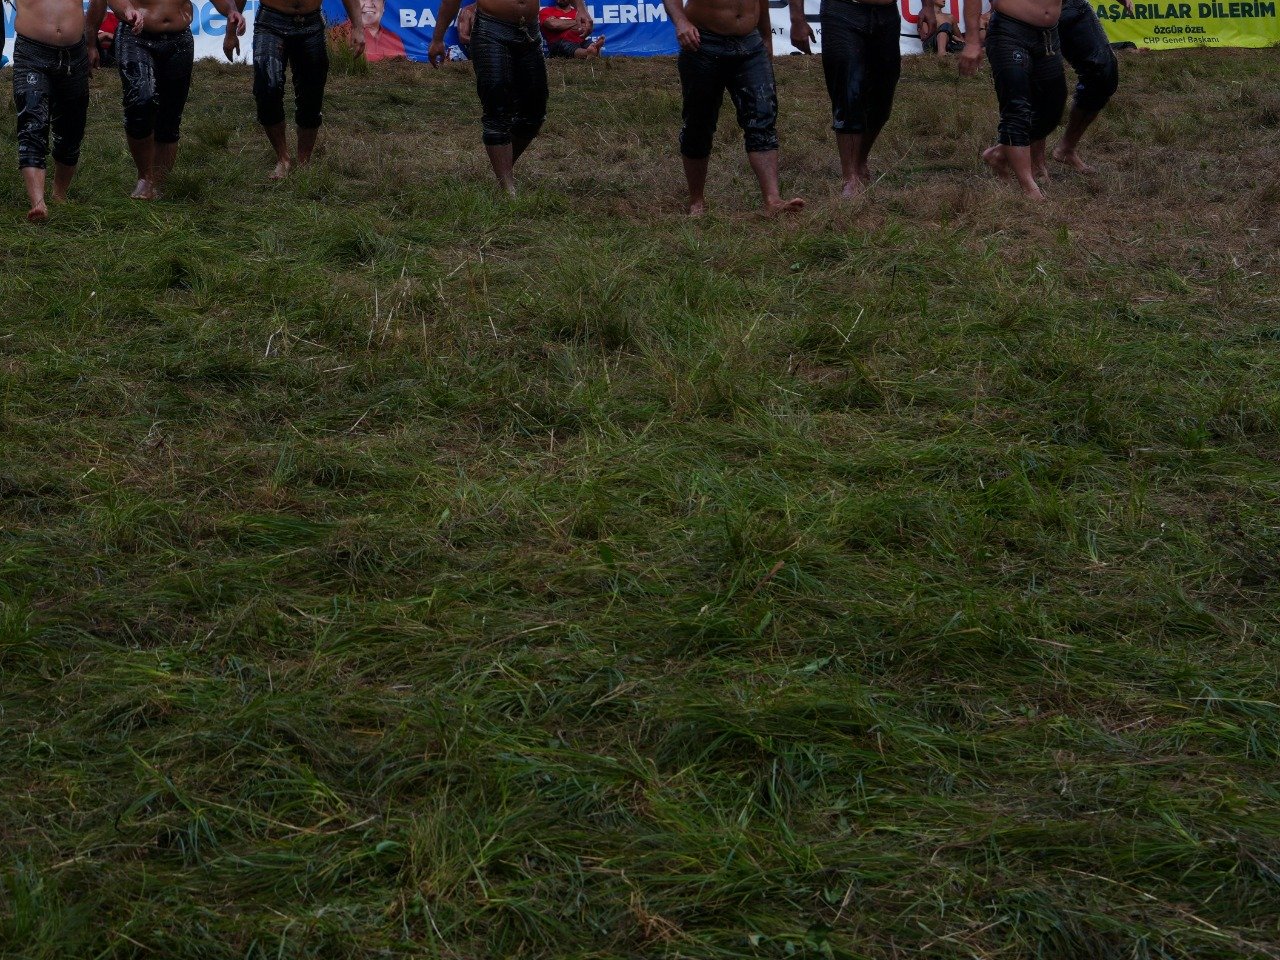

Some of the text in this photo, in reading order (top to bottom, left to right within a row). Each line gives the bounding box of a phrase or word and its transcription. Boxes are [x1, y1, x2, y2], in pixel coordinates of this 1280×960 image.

[1096, 0, 1276, 22] AŞARILAR DİLERİM
[1153, 25, 1207, 34] ÖZGÜR ÖZEL
[1162, 36, 1186, 44] Genel
[1188, 36, 1220, 45] Başkanı
